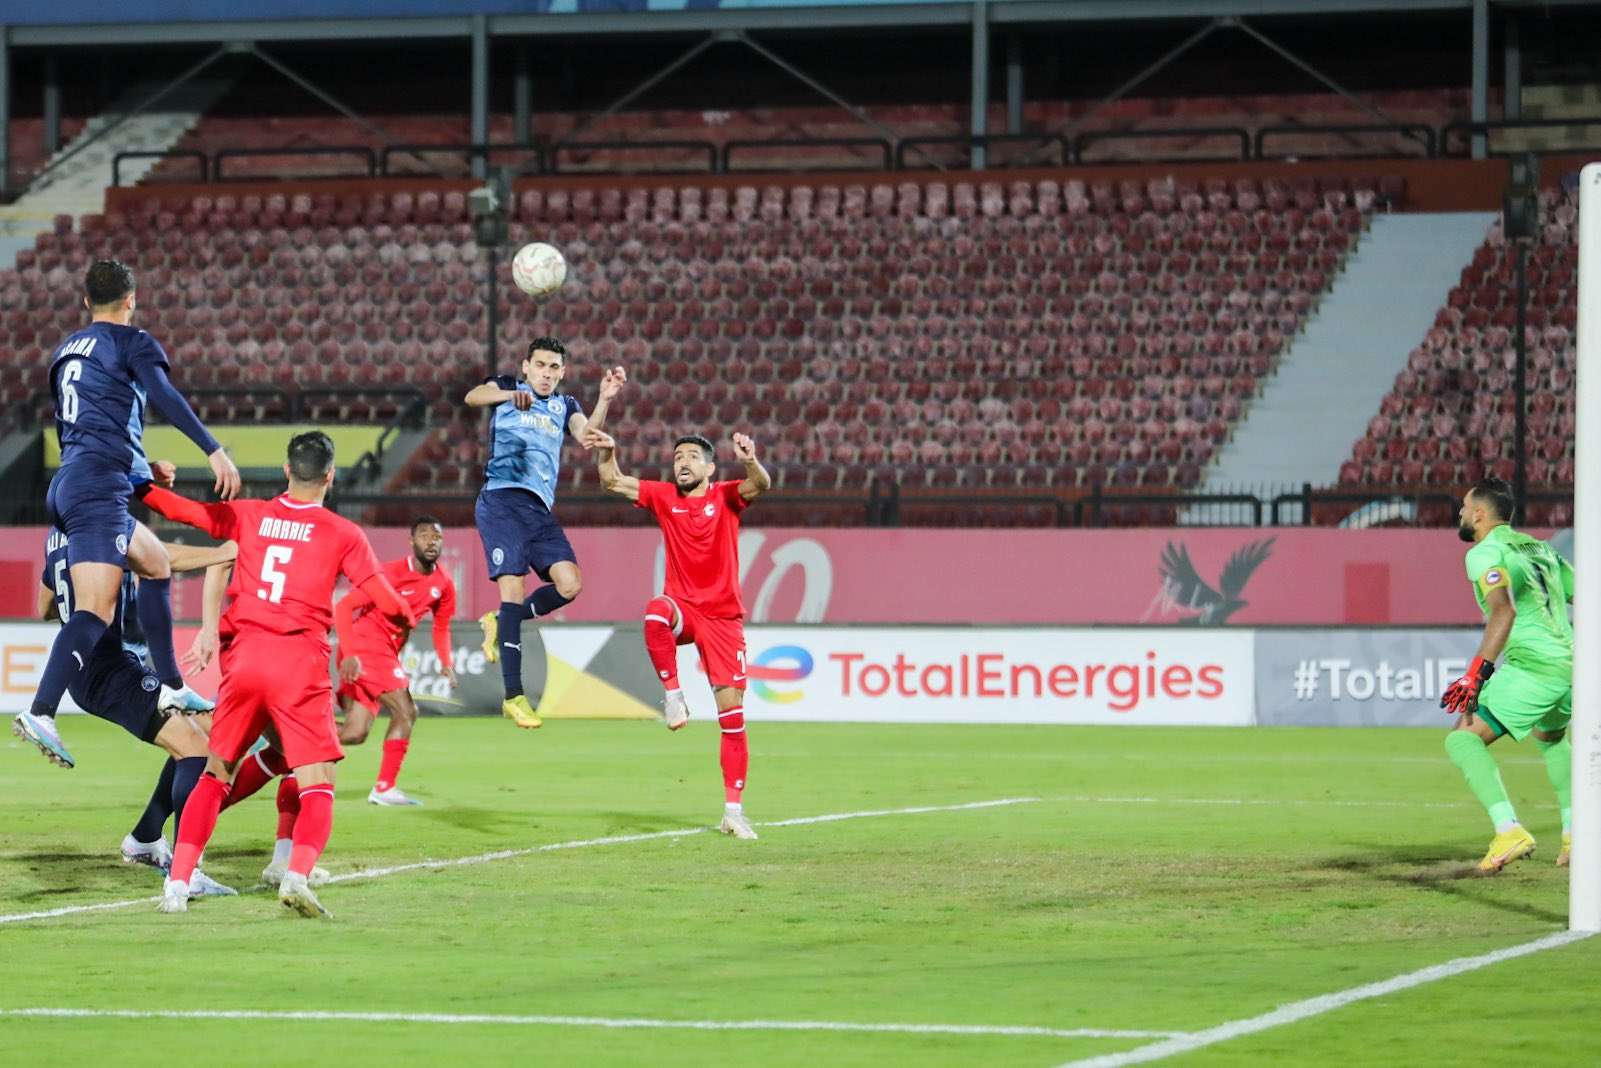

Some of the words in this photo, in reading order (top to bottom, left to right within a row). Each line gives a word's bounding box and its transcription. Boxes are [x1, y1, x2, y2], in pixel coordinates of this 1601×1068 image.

[61, 361, 82, 424] 6
[54, 558, 69, 624] 5
[257, 545, 293, 604] 5
[828, 651, 1224, 712] TotalEnergies
